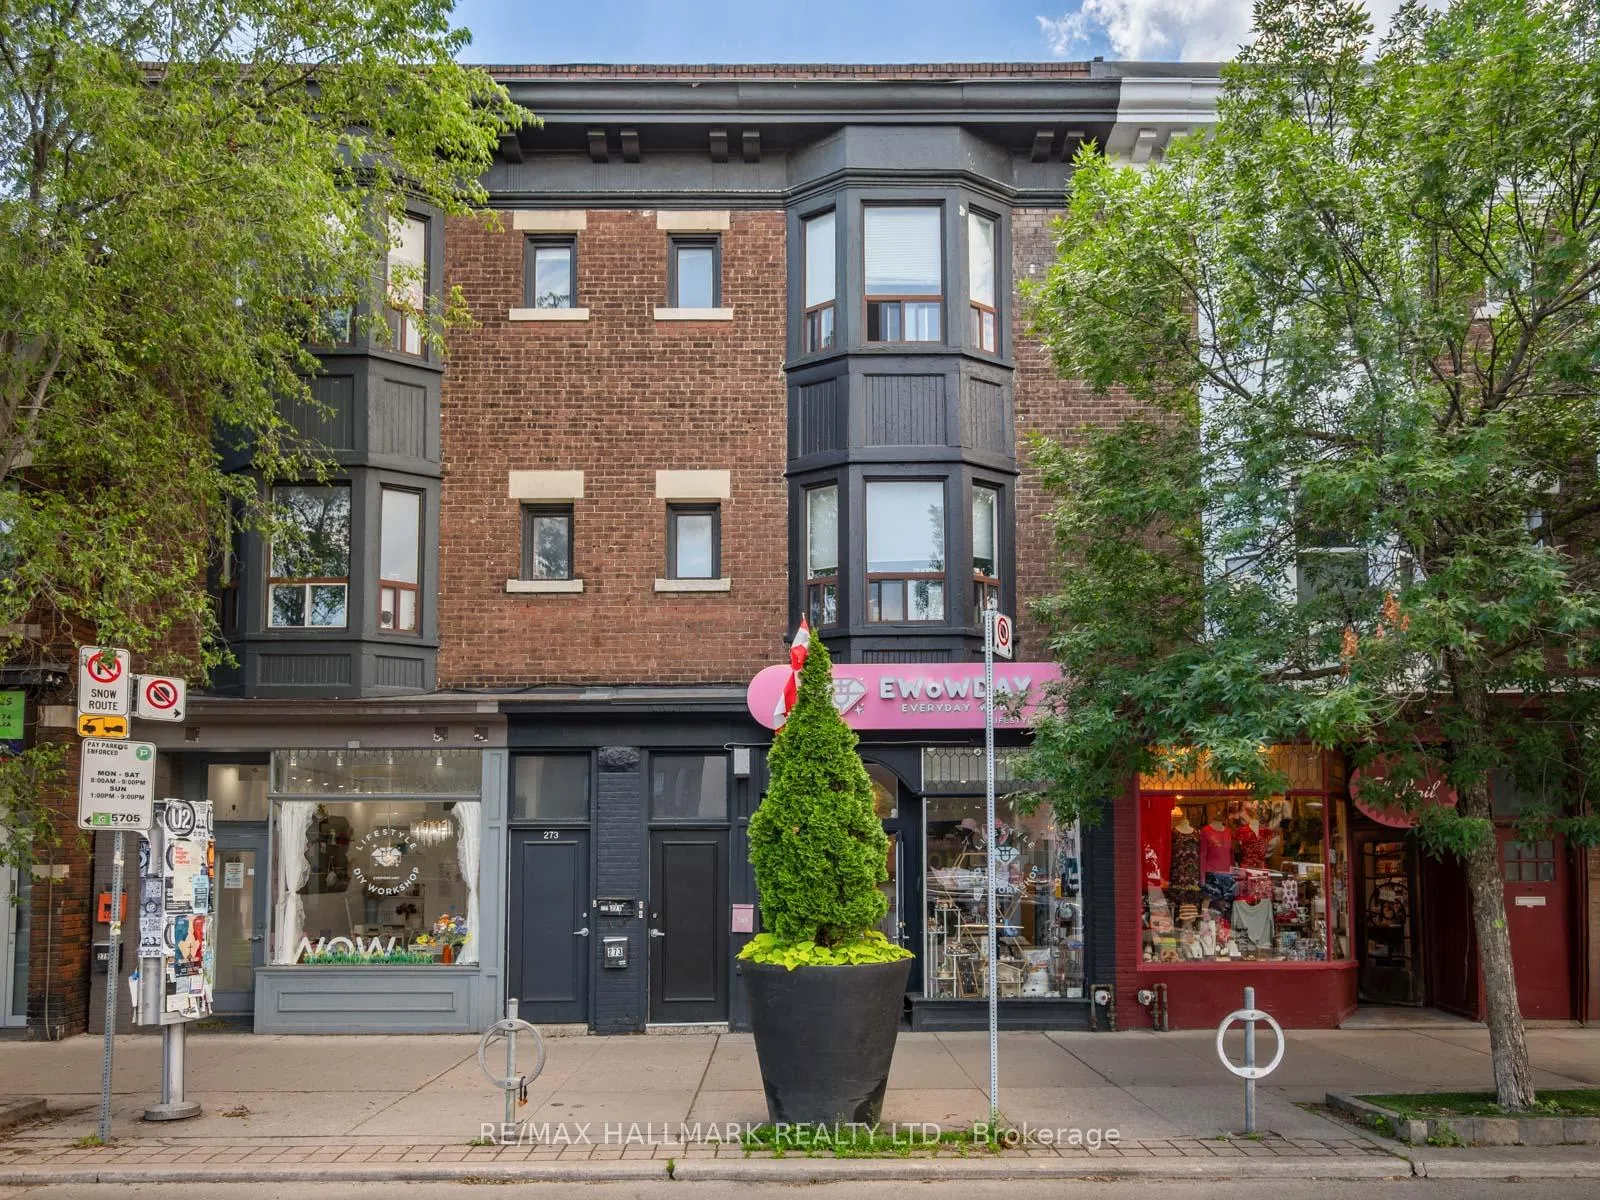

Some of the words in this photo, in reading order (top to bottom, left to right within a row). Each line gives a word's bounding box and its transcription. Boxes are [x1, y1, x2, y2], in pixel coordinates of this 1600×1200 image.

[91, 688, 117, 699] SNOW
[89, 700, 118, 711] ROUTE
[902, 704, 970, 712] EVERYDAY
[111, 813, 141, 822] 5705
[171, 807, 191, 829] U2
[356, 828, 417, 851] LIFESTYLE
[543, 831, 559, 840] 273
[975, 827, 1036, 850] LIESTYLE
[353, 867, 367, 884] DIY
[368, 867, 419, 895] WORKSHOP
[608, 948, 623, 957] 273
